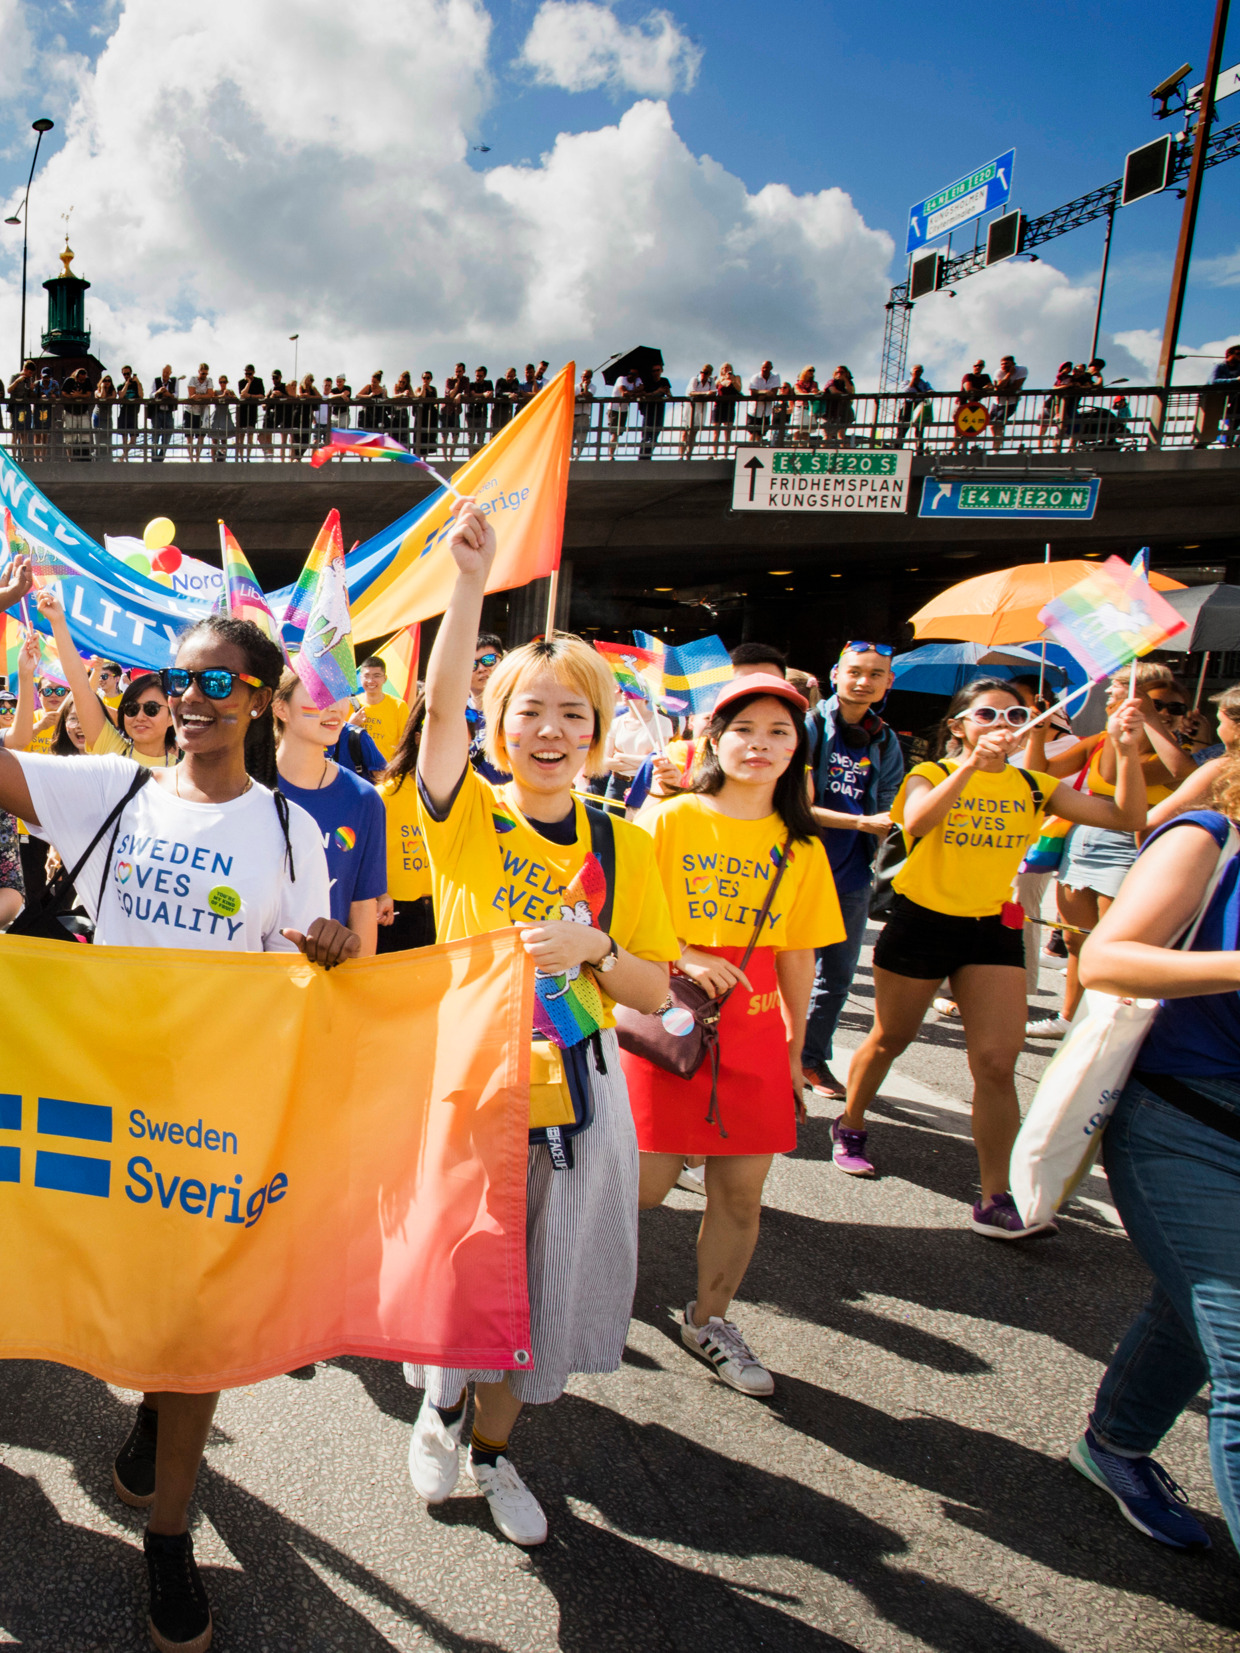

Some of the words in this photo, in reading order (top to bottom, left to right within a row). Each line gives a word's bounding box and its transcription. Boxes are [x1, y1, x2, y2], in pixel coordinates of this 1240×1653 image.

[974, 168, 992, 185] E20
[929, 189, 985, 223] KUNGSHOLMEN
[779, 456, 802, 471] E4
[811, 457, 822, 471] S
[835, 457, 872, 471] E20
[880, 458, 891, 472] S
[769, 477, 904, 493] FRIDHEMSPLAN
[479, 487, 530, 516] erige
[768, 493, 902, 509] KUNGSHOLMEN
[967, 490, 990, 504] E4
[997, 490, 1011, 504] N
[1023, 491, 1063, 505] E20
[1070, 491, 1083, 505] N
[952, 797, 1026, 813] SWEDEN
[116, 834, 234, 877] SWEDEN
[688, 899, 782, 930] EQLITY
[128, 1108, 238, 1155] Sweden
[124, 1155, 289, 1229] Sverige
